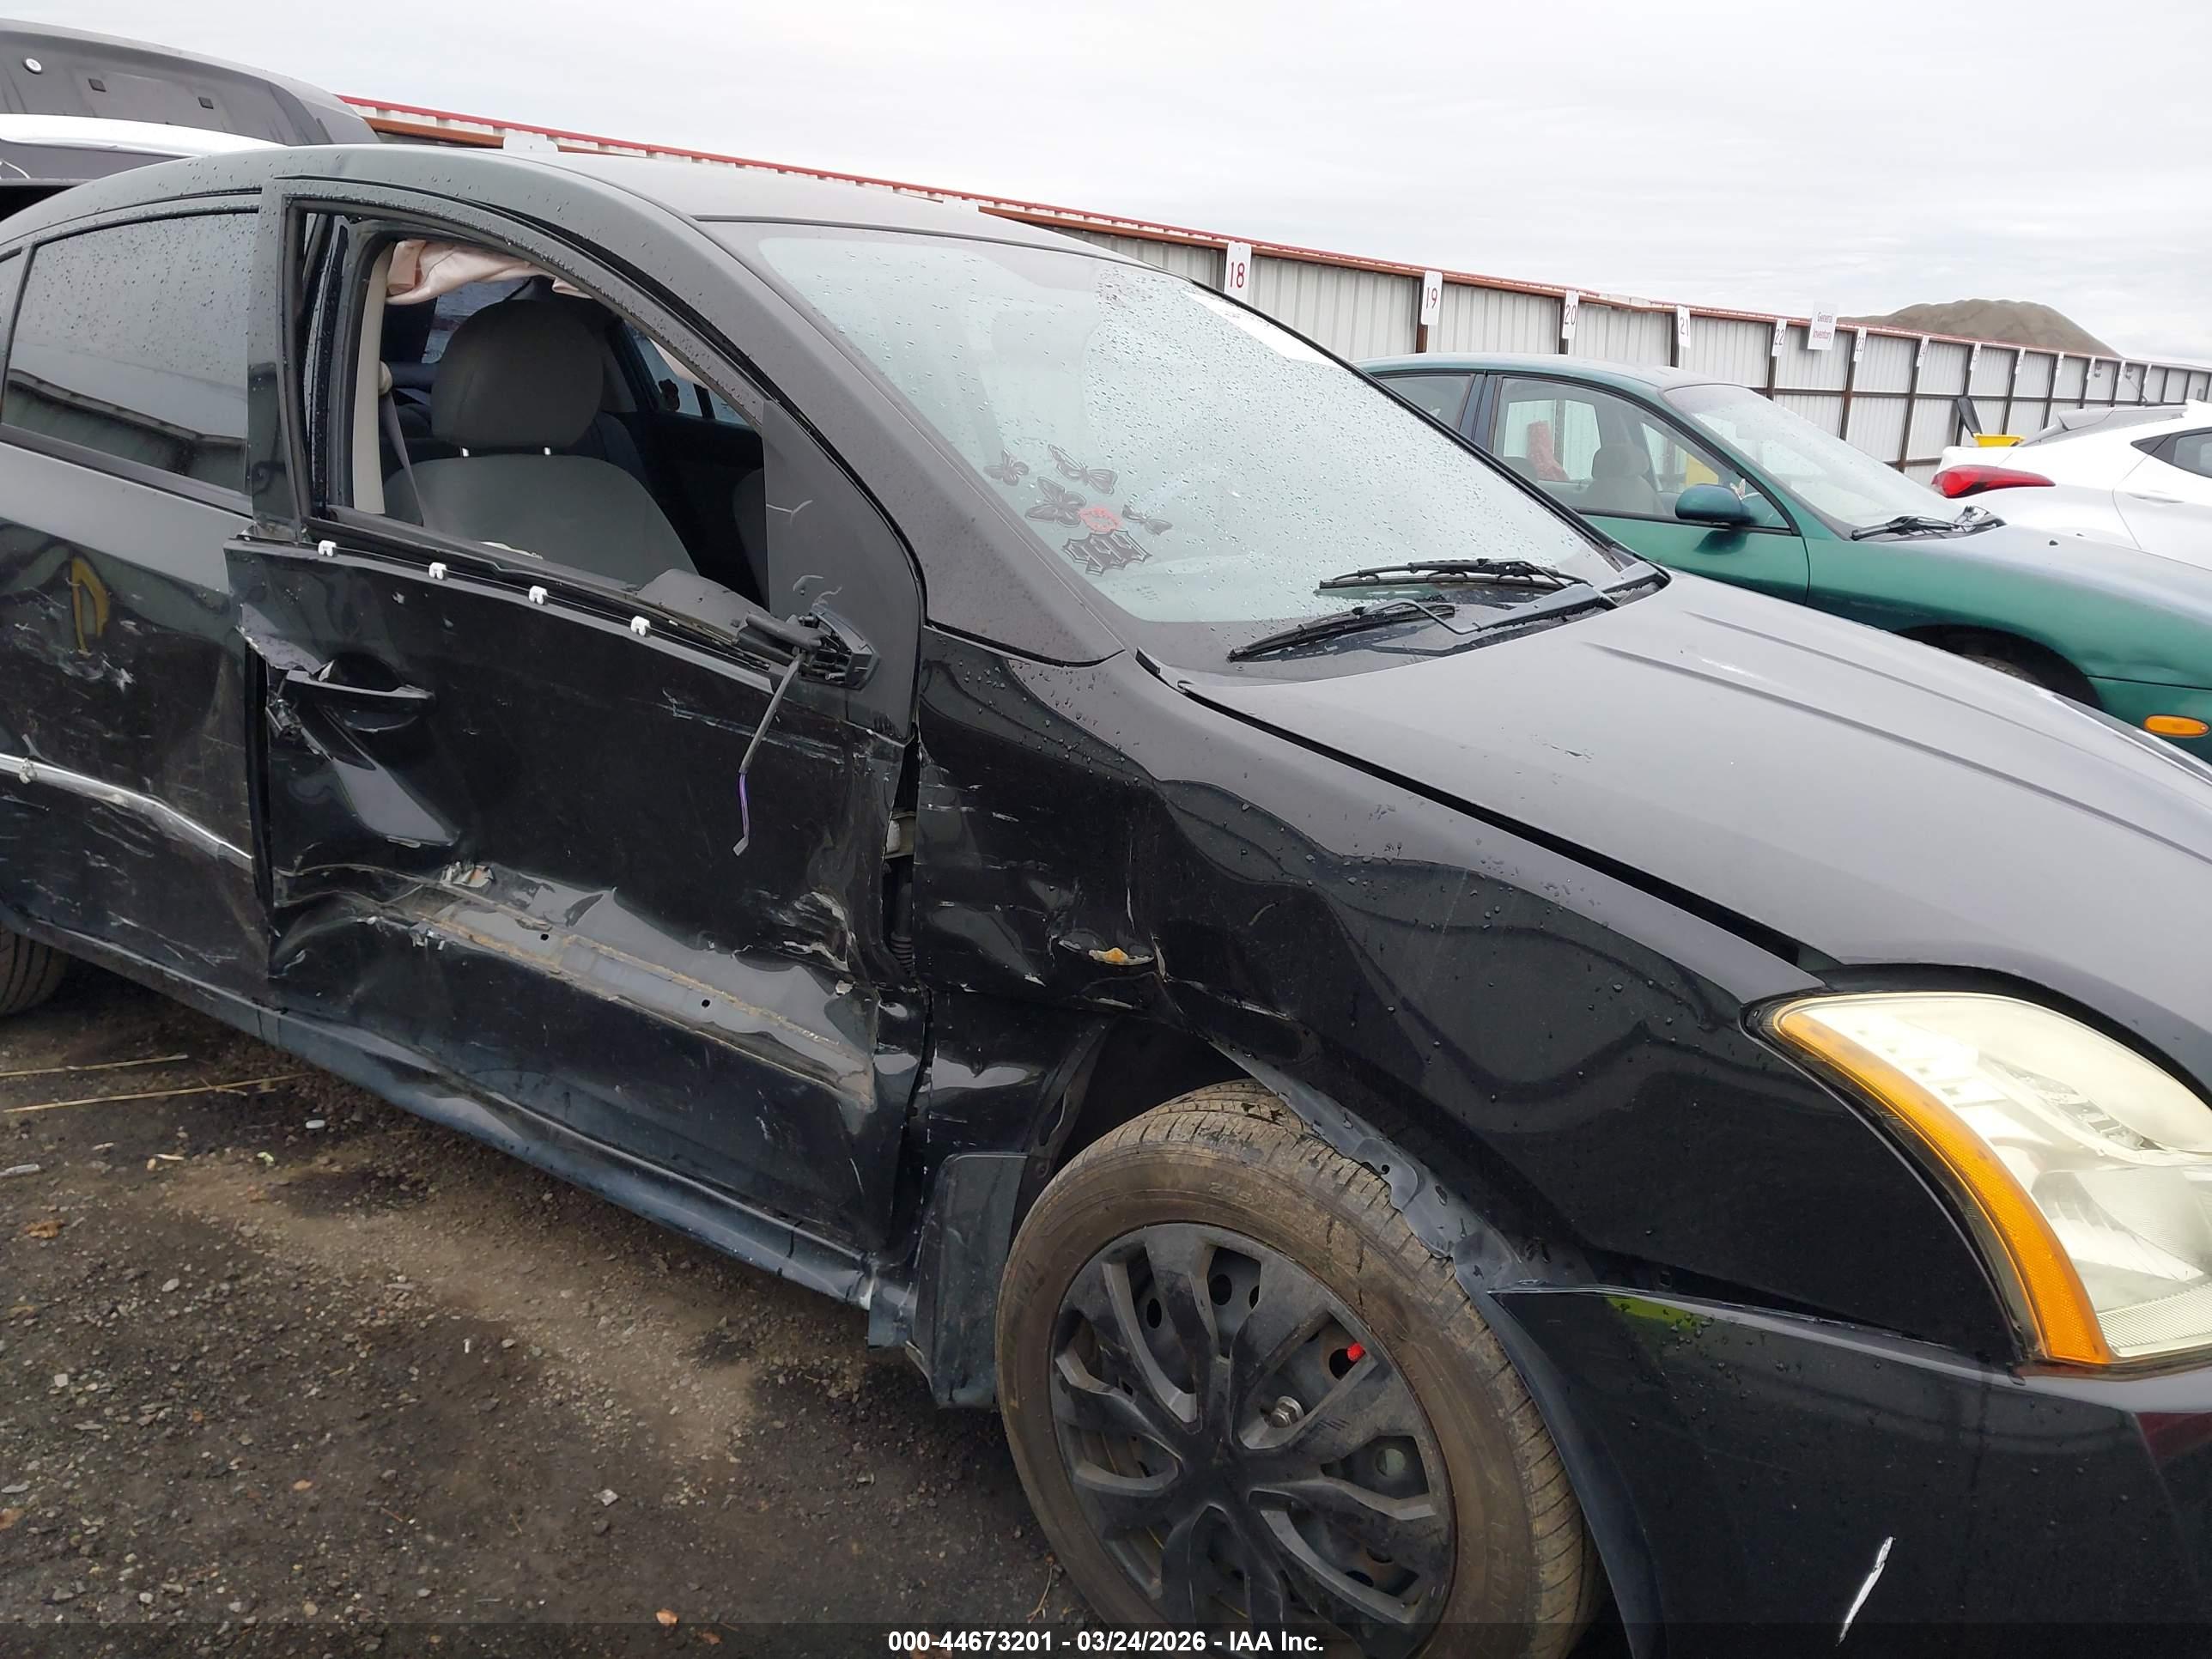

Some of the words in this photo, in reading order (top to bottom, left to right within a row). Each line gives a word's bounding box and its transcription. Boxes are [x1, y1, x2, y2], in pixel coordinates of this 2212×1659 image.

[1230, 261, 1245, 289] 18
[1425, 287, 1438, 310] 19
[1564, 303, 1577, 325] 20
[1679, 316, 1689, 337] 21
[1773, 327, 1785, 346] 22
[1856, 336, 1865, 352] 23
